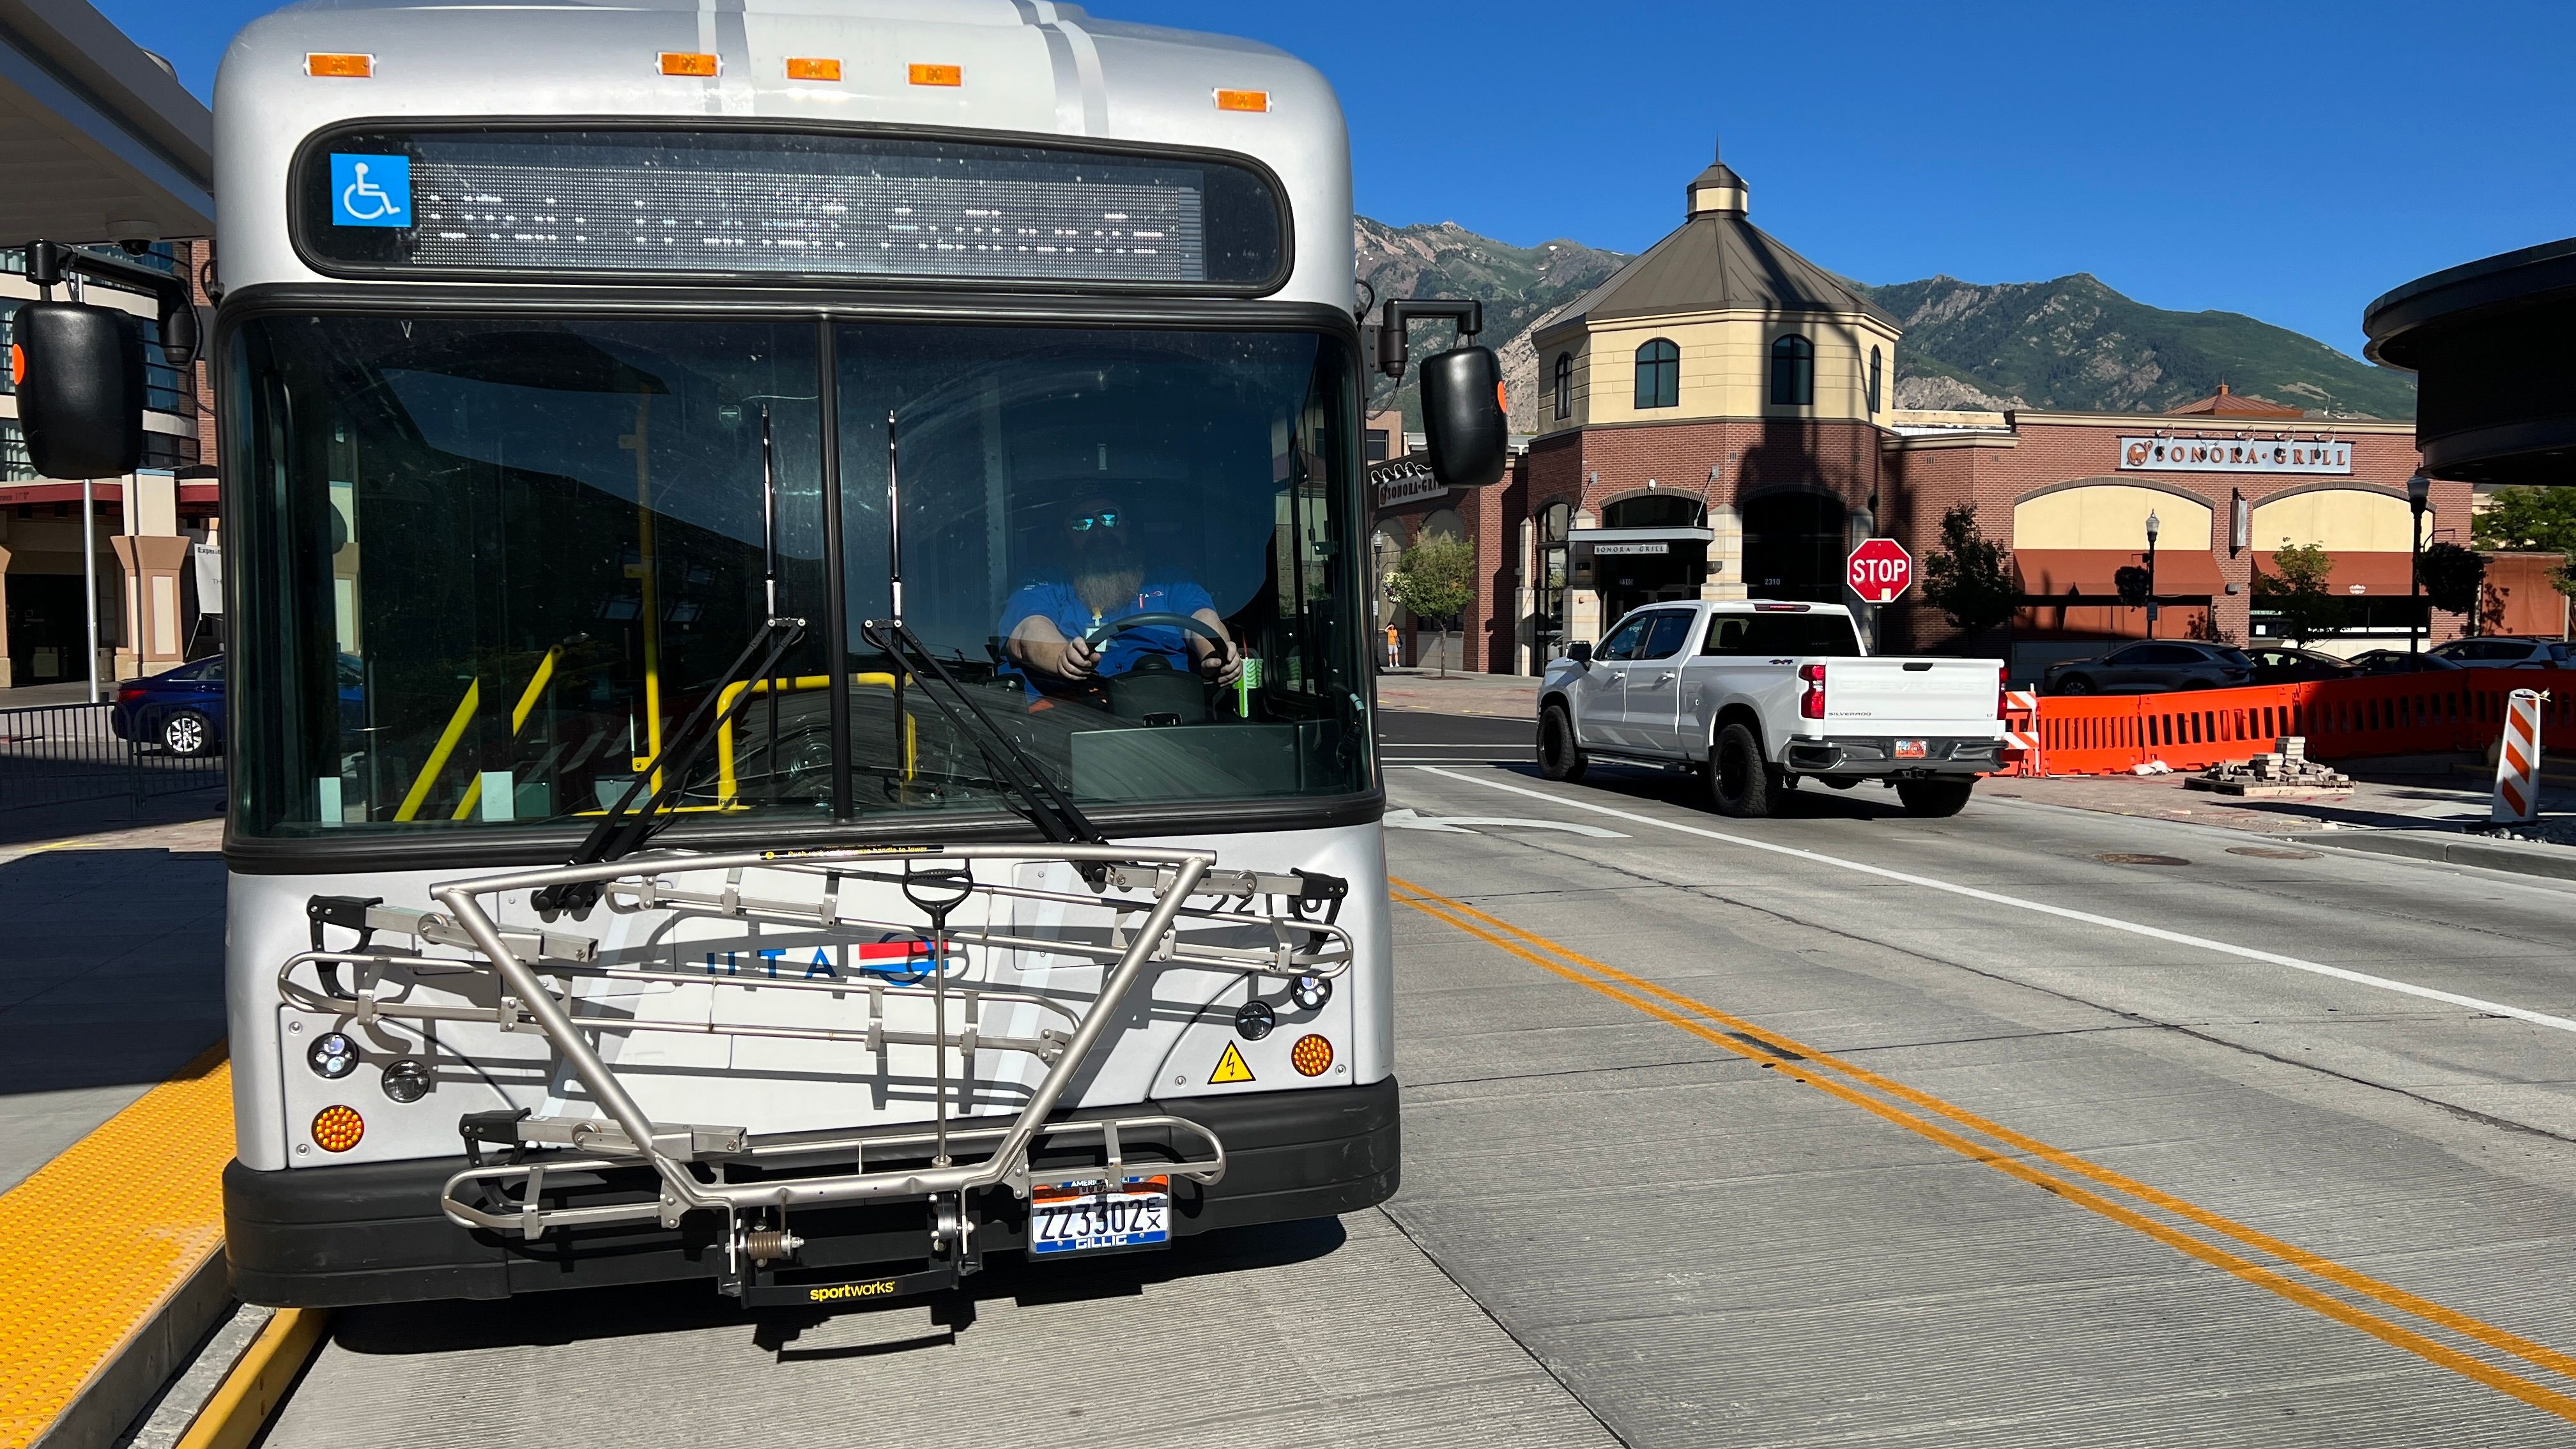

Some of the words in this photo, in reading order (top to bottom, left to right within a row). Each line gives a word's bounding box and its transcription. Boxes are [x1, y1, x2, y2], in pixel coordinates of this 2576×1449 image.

[2156, 445, 2258, 464] SONORA
[2274, 447, 2346, 466] GRILL
[1387, 480, 1418, 500] SONORA
[1852, 558, 1906, 583] STOP
[1039, 1199, 1144, 1240] 223302
[1075, 1234, 1128, 1250] GILLIG
[809, 1281, 894, 1302] sportworks
